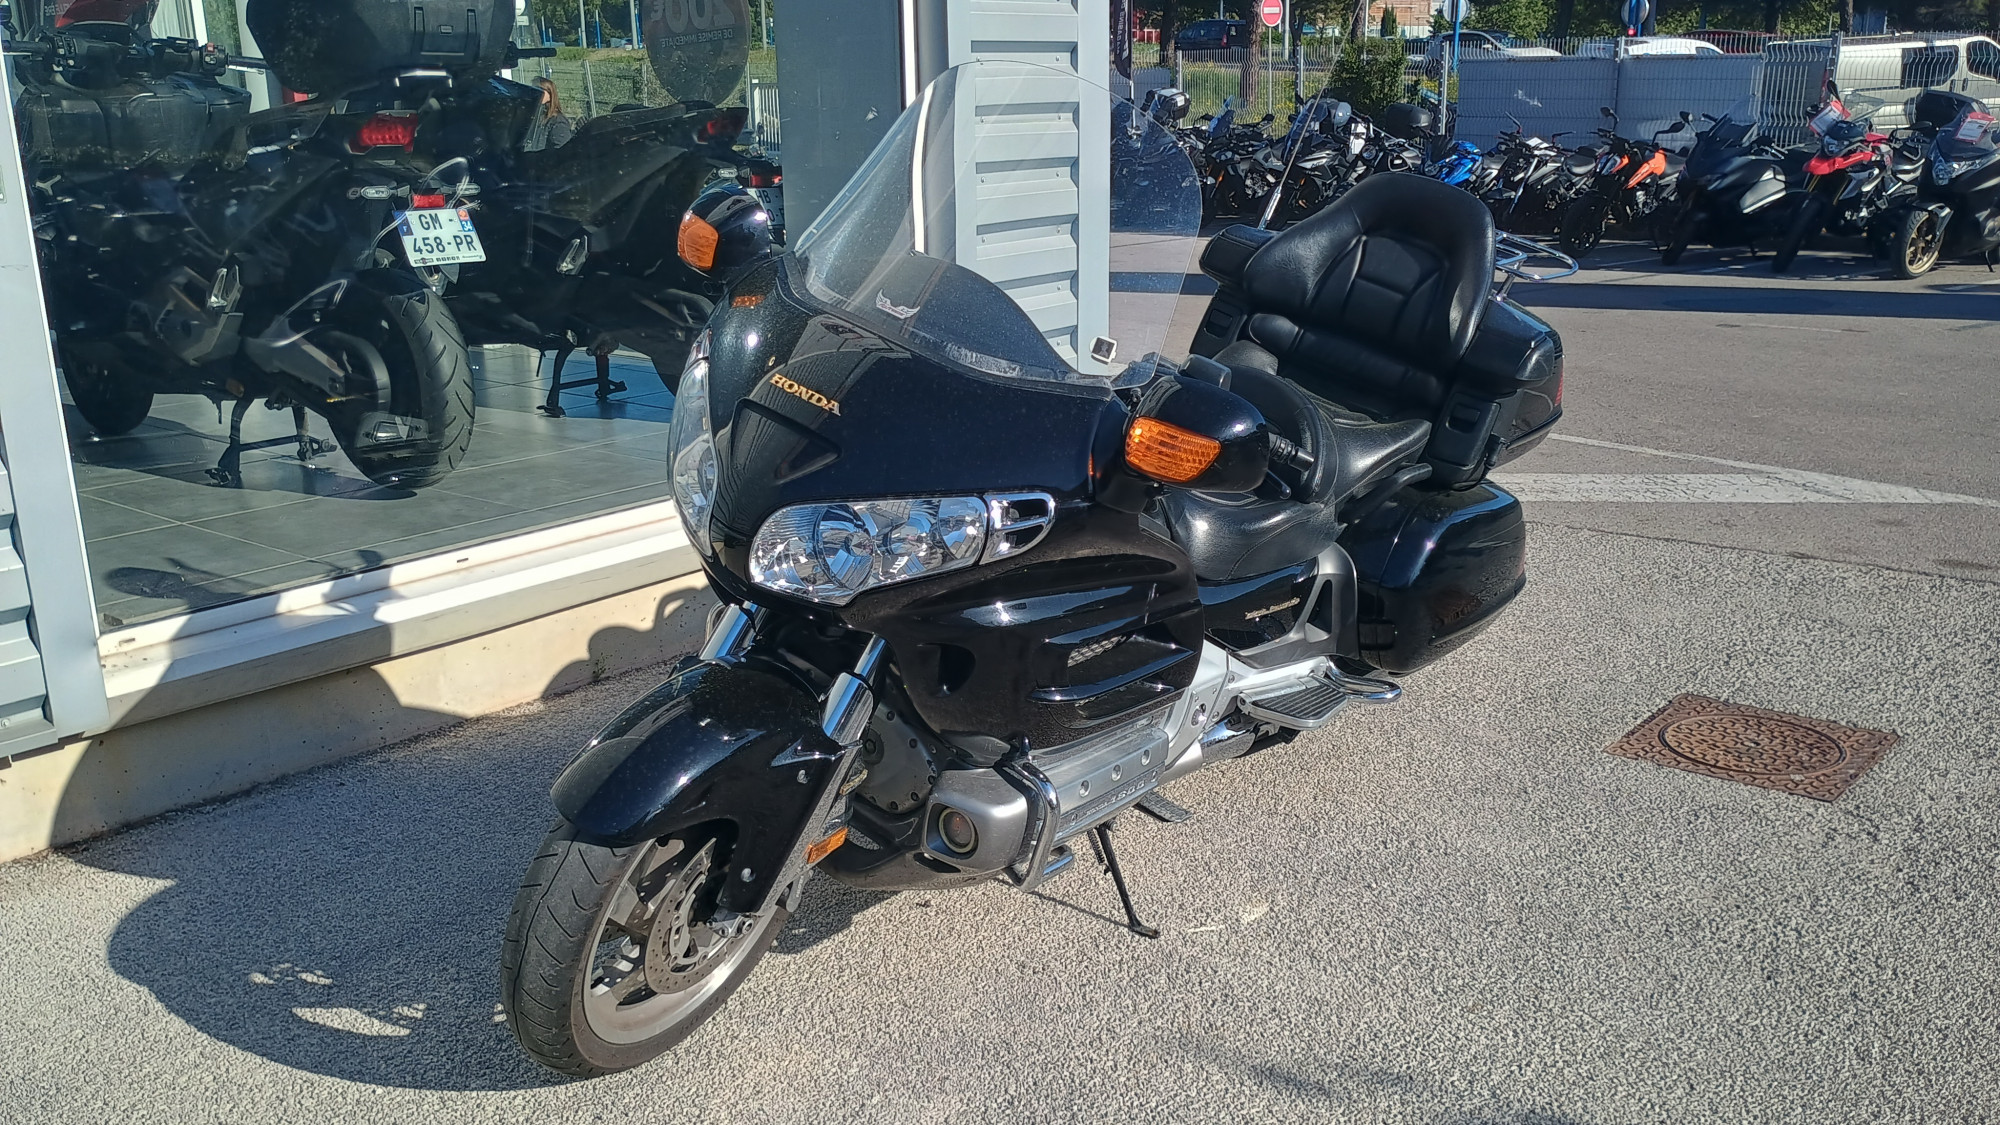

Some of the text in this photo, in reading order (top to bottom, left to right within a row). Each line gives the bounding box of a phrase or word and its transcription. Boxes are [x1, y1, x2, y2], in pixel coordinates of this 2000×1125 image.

[418, 213, 443, 231] GM
[461, 220, 473, 232] 34
[413, 234, 477, 255] 458-PR
[769, 373, 842, 417] HONDA
